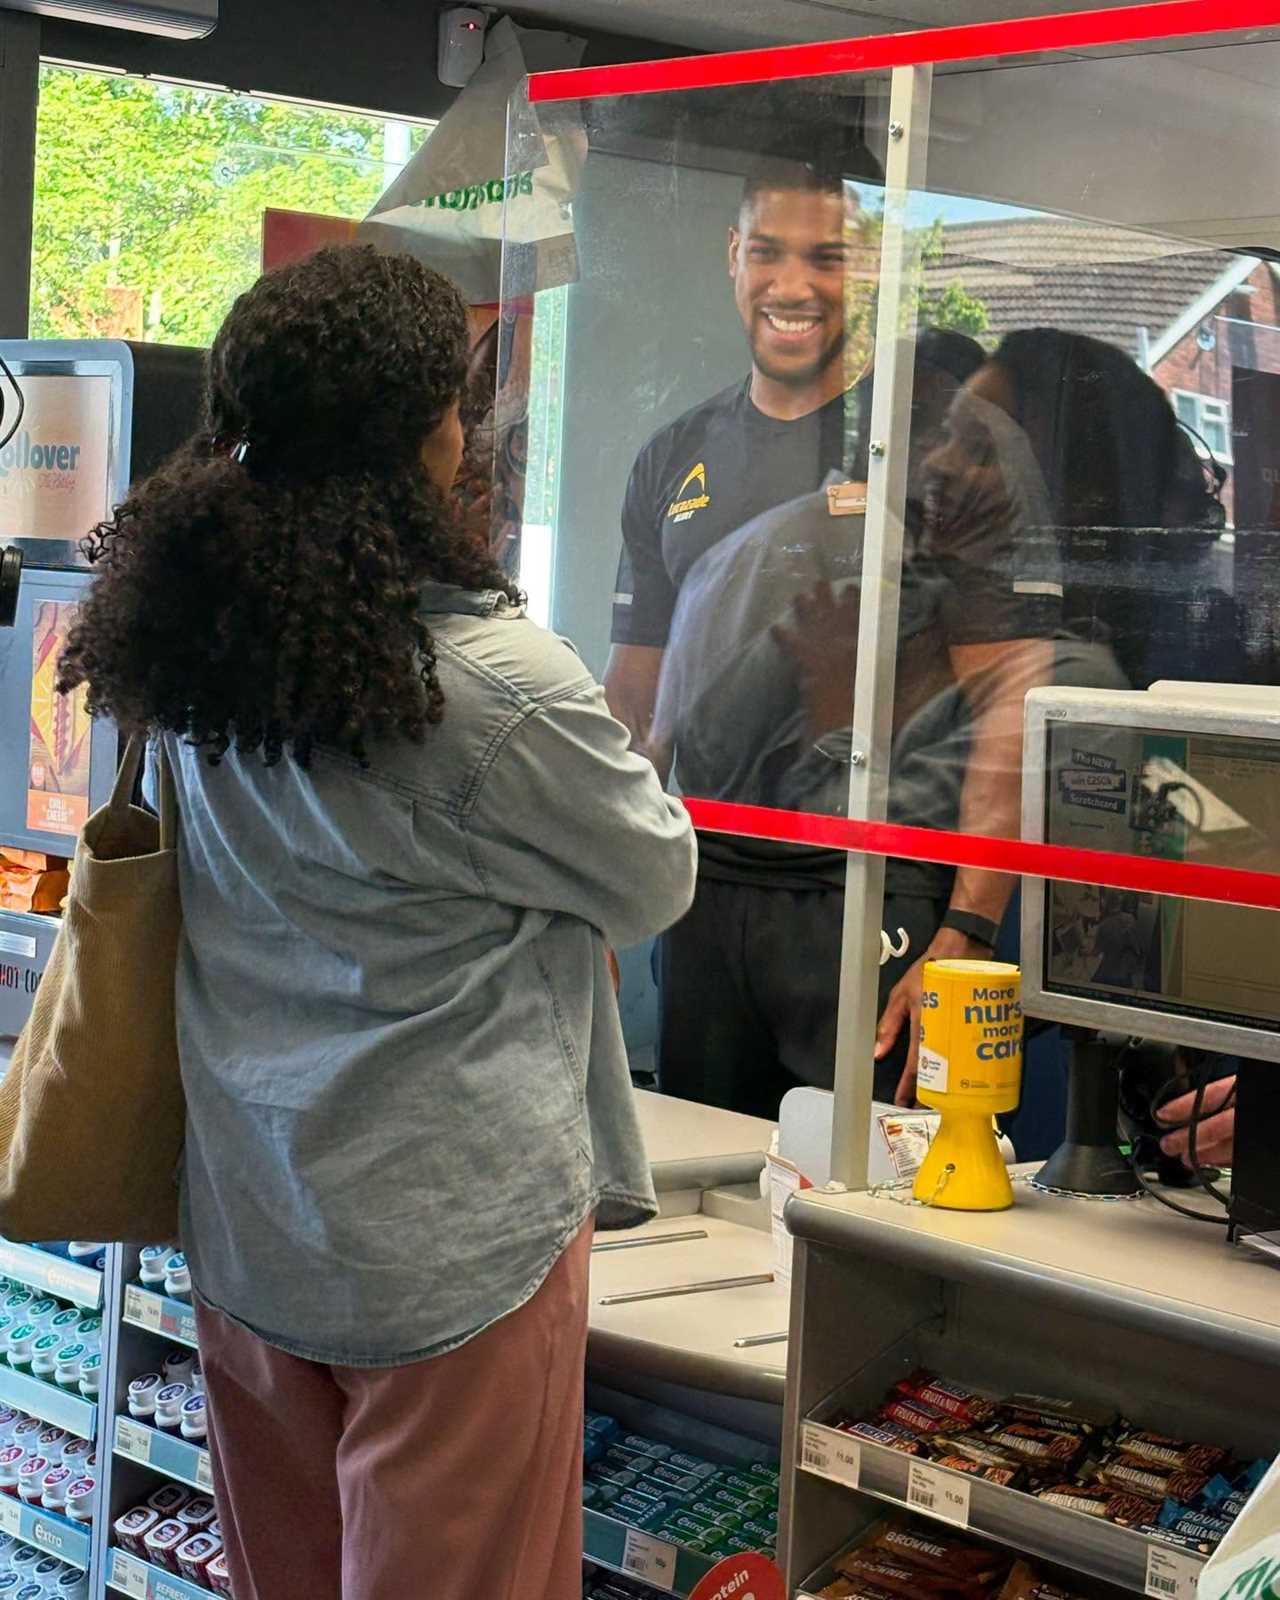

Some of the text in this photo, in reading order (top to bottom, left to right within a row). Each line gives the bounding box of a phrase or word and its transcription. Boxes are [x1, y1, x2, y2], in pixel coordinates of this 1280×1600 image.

[0, 432, 80, 477] ollover
[973, 988, 1015, 1000] More
[885, 1531, 947, 1557] BROWNIE
